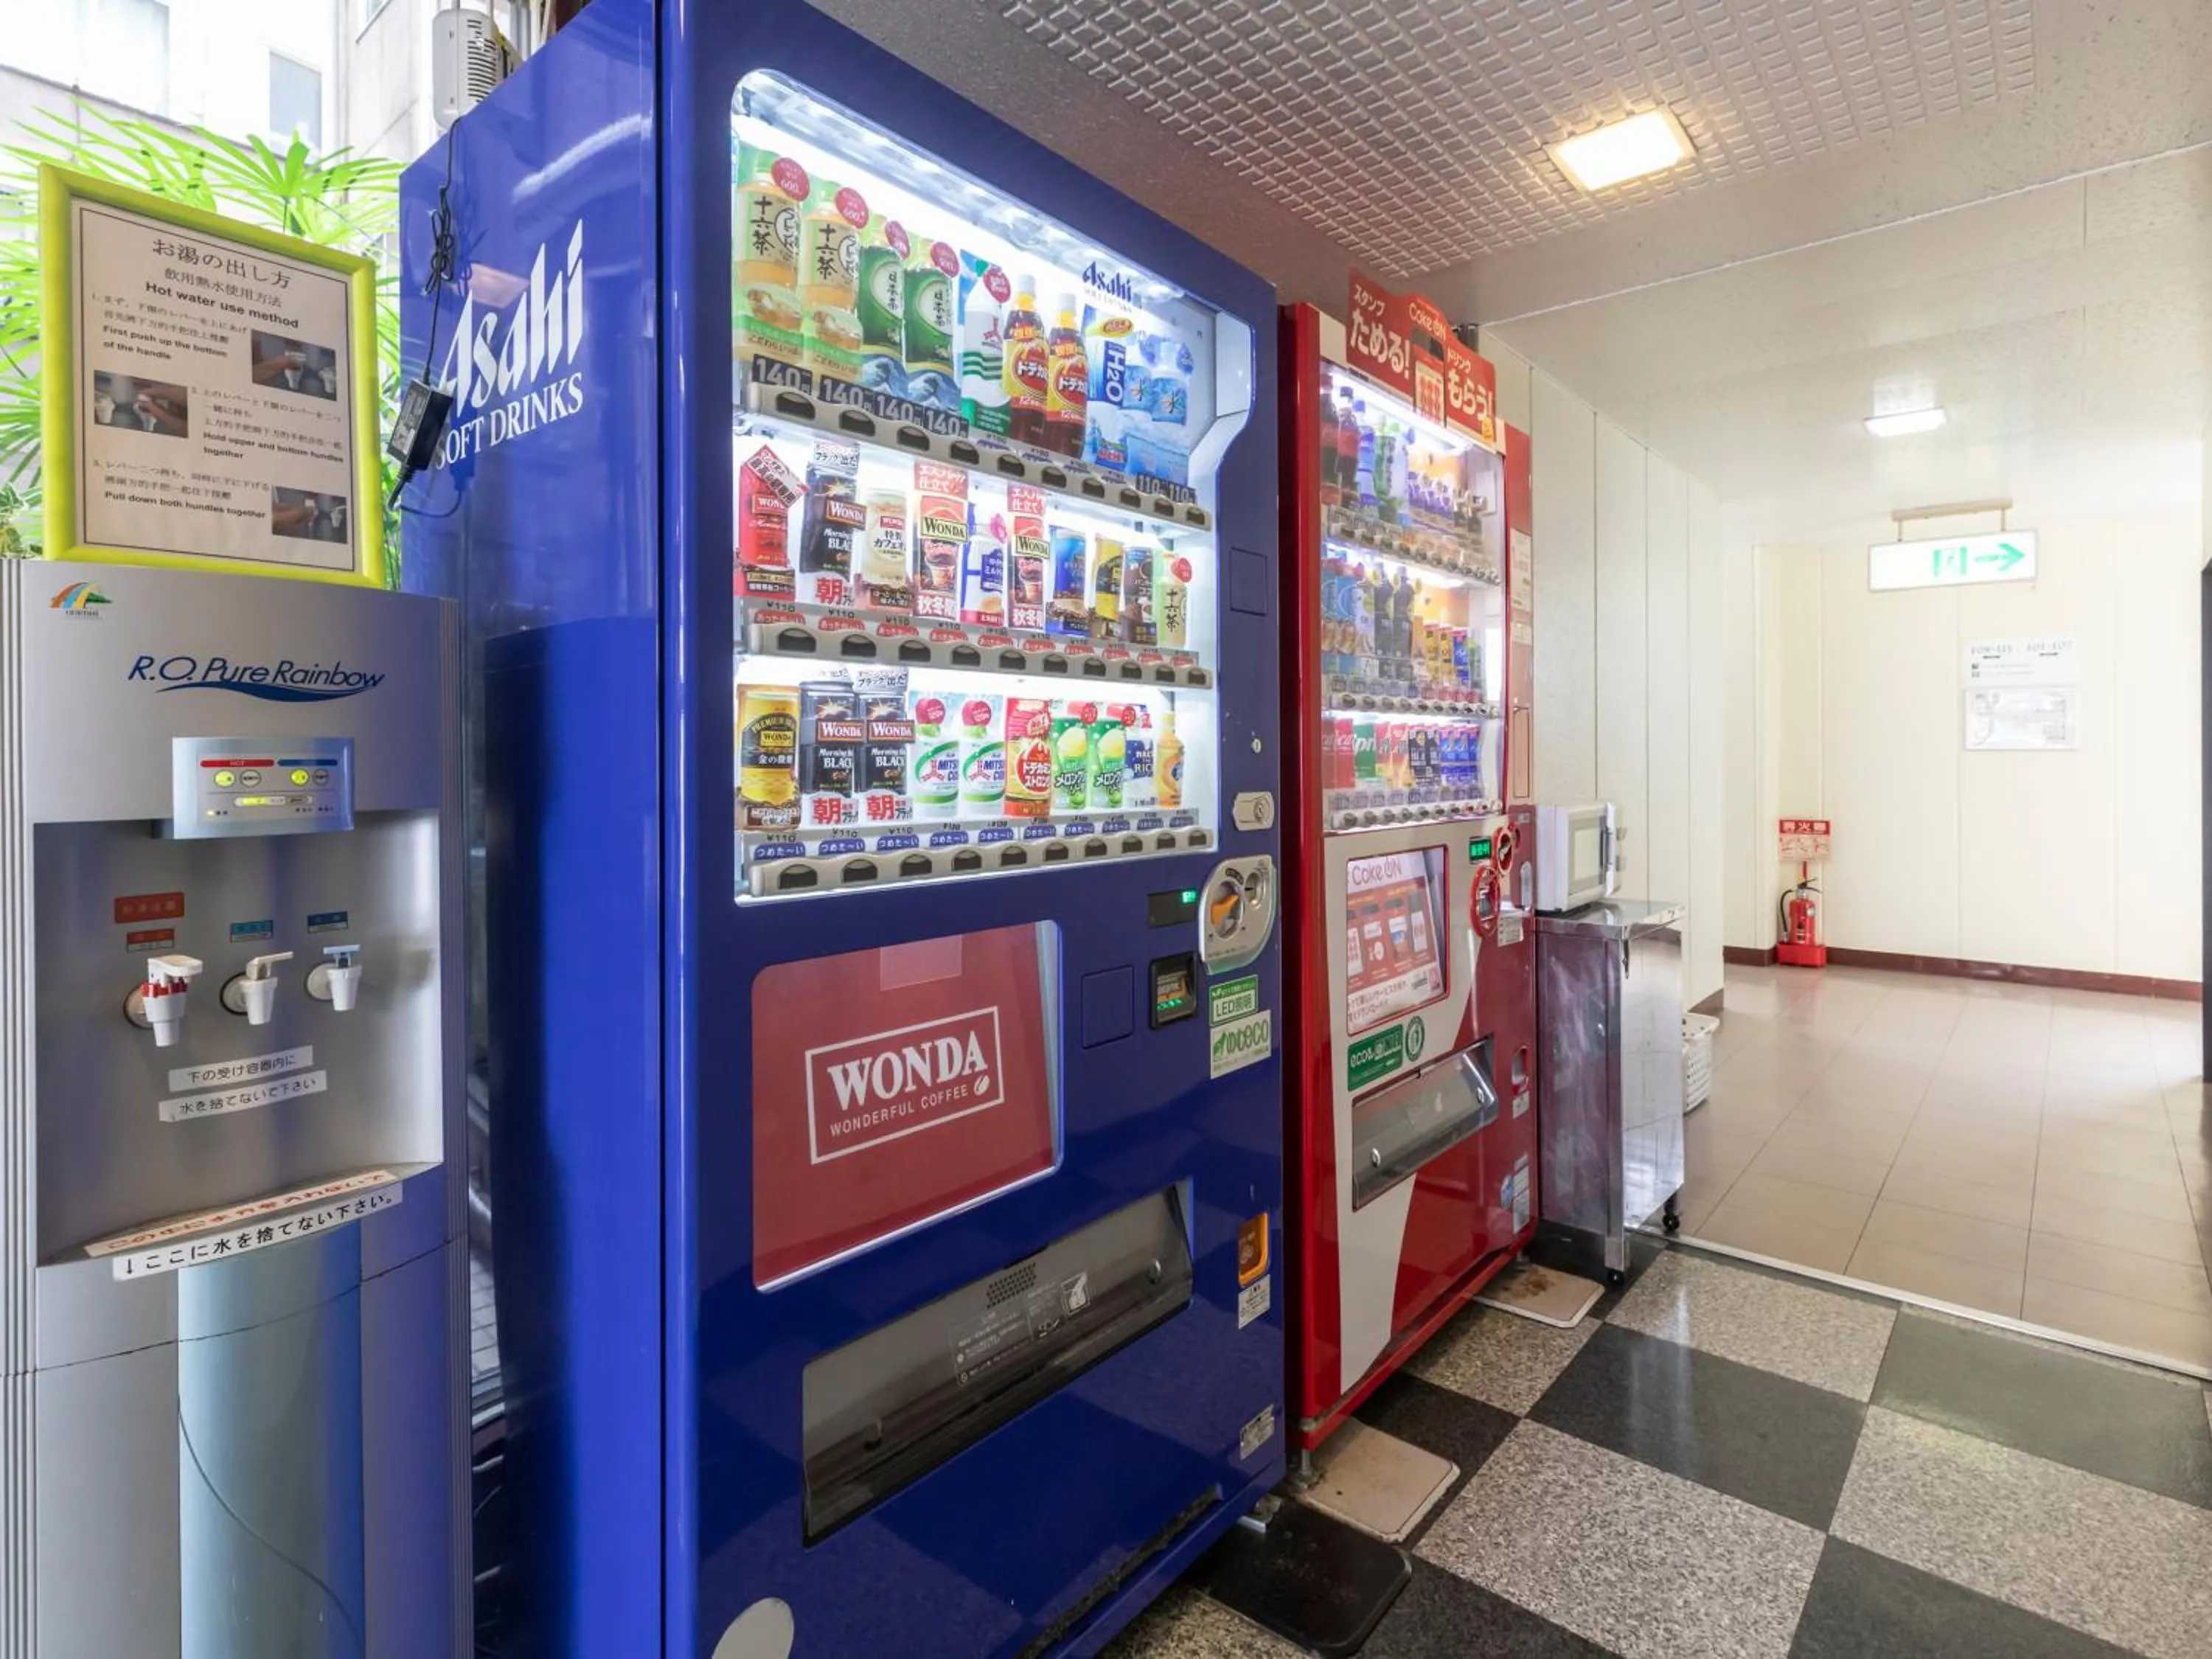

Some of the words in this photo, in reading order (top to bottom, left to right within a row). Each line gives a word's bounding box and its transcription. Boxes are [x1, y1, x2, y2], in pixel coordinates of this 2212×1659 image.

[749, 195, 776, 256] 十六茶
[152, 237, 292, 291] お湯の出し方
[815, 224, 838, 279] 十六茶
[1082, 260, 1132, 302] Asahi
[146, 282, 173, 297] Hot
[175, 291, 216, 307] water
[220, 302, 246, 316] use
[248, 307, 300, 329] method
[438, 218, 582, 417] Asahi
[1409, 302, 1432, 330] Coke
[102, 324, 128, 338] First
[131, 329, 156, 344] push
[159, 335, 173, 347] up
[175, 338, 191, 350] the
[103, 340, 115, 349] of
[117, 342, 134, 353] the
[756, 358, 801, 392] 140
[823, 379, 864, 406] 140
[490, 372, 582, 448] DRINKS
[876, 395, 914, 421] 140
[927, 410, 959, 436] 140
[203, 431, 227, 442] Hold
[229, 437, 257, 448] upper
[257, 442, 276, 451] and
[203, 445, 245, 459] together
[105, 490, 127, 501] Pull
[128, 494, 158, 506] down
[160, 498, 184, 509] both
[226, 507, 267, 519] together
[925, 517, 965, 538] WONDA
[815, 577, 843, 605] 朝
[766, 600, 796, 613] ¥110
[828, 608, 855, 619] ¥110
[1164, 588, 1180, 633] 十六茶
[128, 655, 195, 681] R.O.
[203, 657, 271, 684] Pure
[271, 660, 386, 688] Rainbow
[763, 731, 792, 742] WONDA
[821, 721, 862, 737] WONDA
[871, 721, 911, 737] WONDA
[813, 797, 842, 825] 朝
[866, 795, 895, 821] 朝
[767, 832, 797, 843] ¥110
[832, 827, 858, 838] ¥110
[888, 827, 914, 835] ¥110
[1352, 863, 1382, 886] Coke
[189, 1054, 296, 1084] 下の受け容器内に
[827, 1030, 988, 1112] WONDA
[180, 1078, 316, 1114] 水を捨てないで下さい
[830, 1101, 916, 1138] WONDERFUL
[921, 1084, 969, 1110] COFFEE
